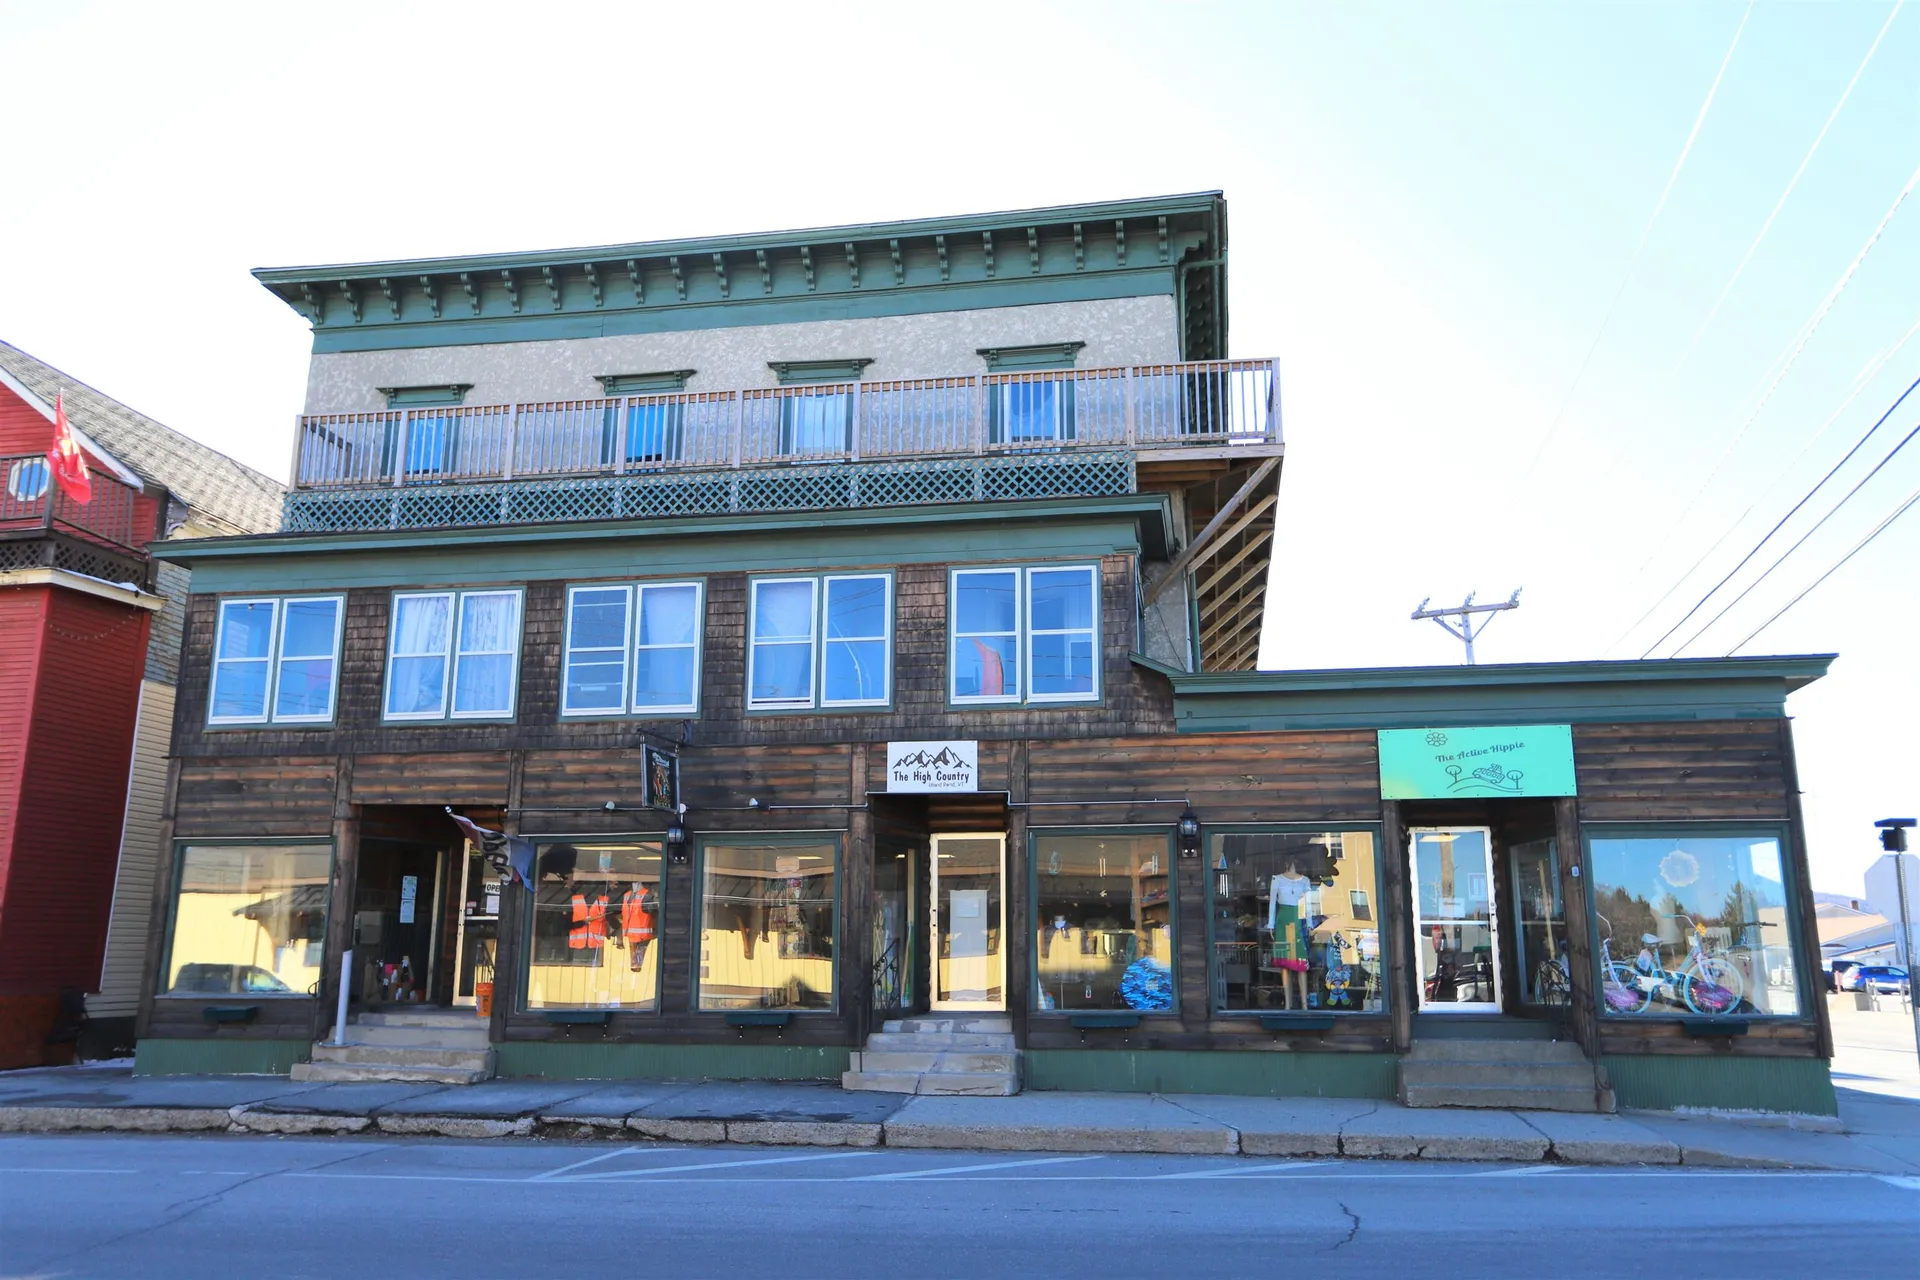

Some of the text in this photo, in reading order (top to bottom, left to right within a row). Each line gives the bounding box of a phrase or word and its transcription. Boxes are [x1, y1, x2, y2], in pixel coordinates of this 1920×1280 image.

[1435, 741, 1525, 763] The Active Hippie
[894, 770, 970, 784] The High Country
[486, 884, 500, 892] OPE
